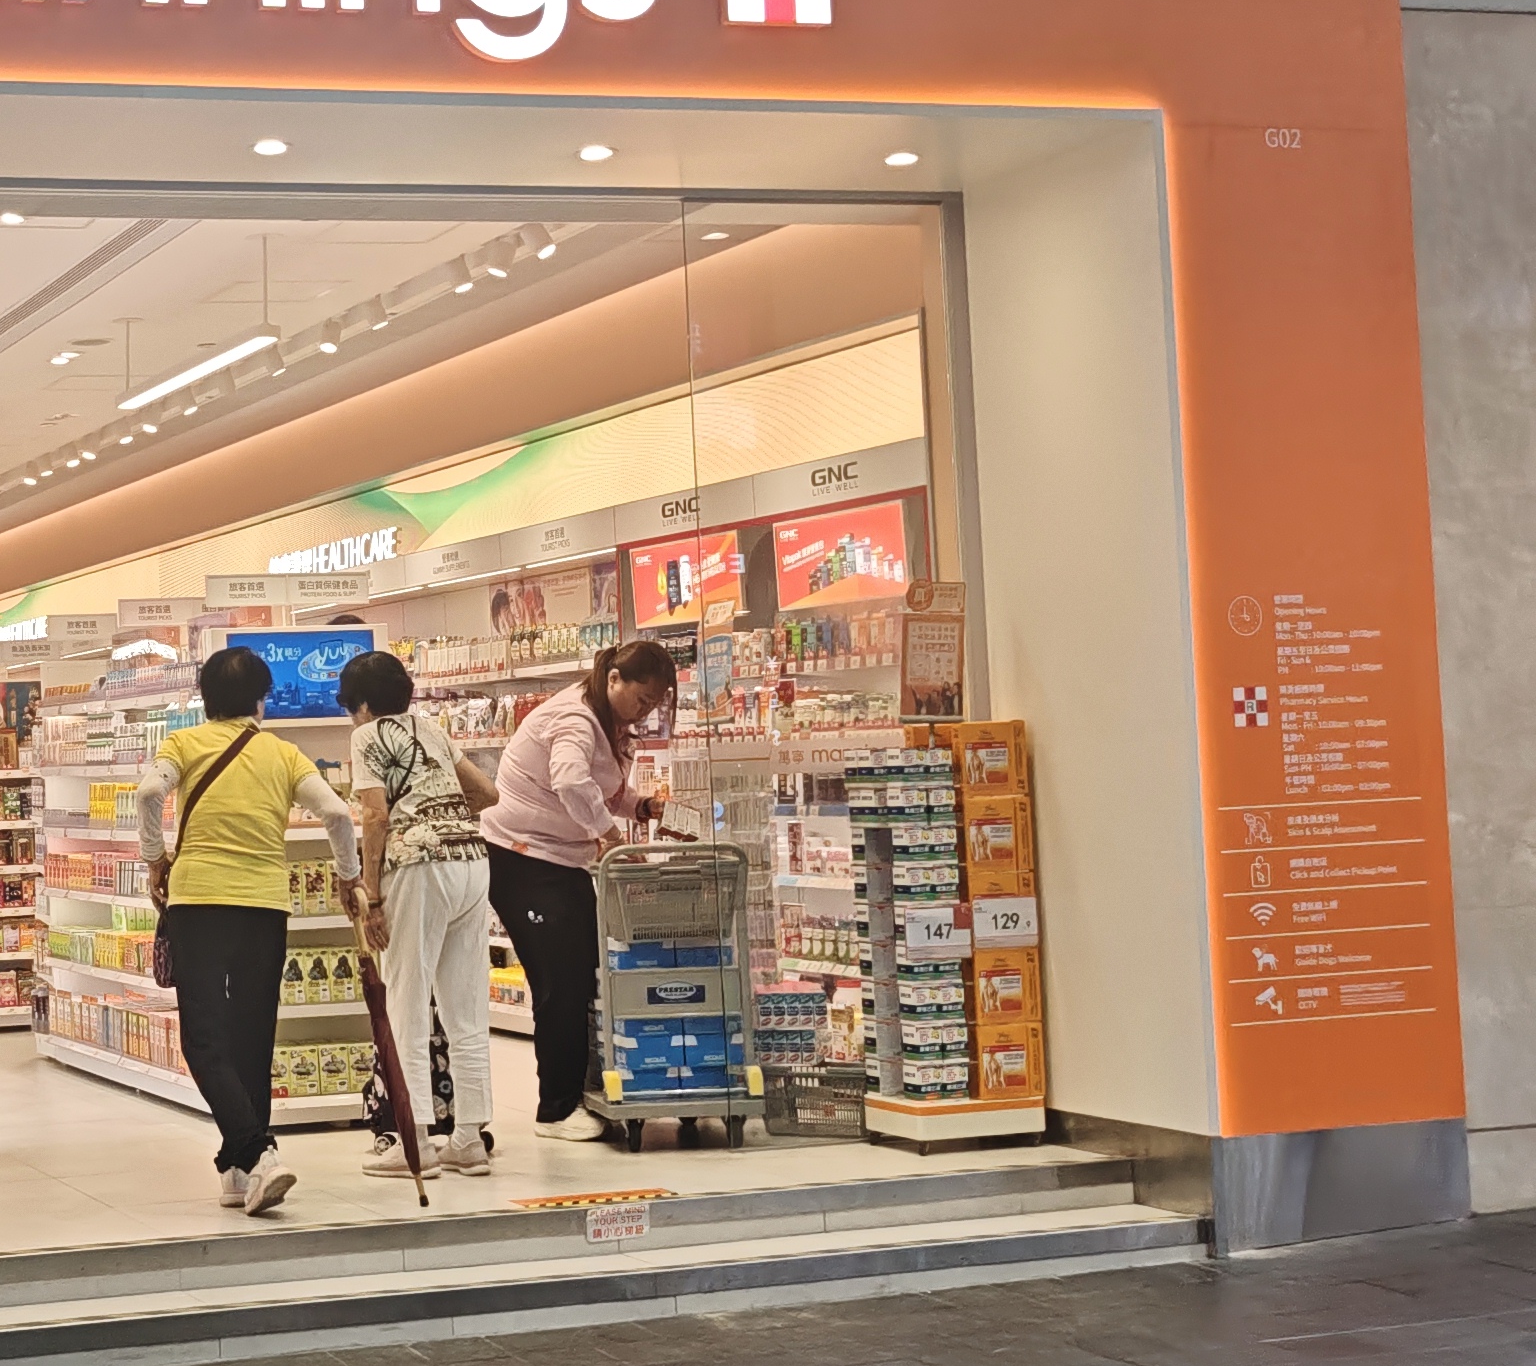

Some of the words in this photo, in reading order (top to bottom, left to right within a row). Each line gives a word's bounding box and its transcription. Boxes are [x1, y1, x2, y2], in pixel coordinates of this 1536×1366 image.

[1265, 128, 1301, 148] G02
[811, 461, 859, 487] GNC
[812, 485, 831, 497] LIVE
[835, 481, 859, 494] WELL
[661, 496, 700, 518] GNC
[662, 516, 679, 527] LIVE
[312, 526, 398, 573] HEALTHCARE
[228, 582, 265, 592] 旅客首選
[298, 580, 359, 591] 蛋白質保健食品
[138, 605, 171, 614] 旅客首選
[991, 912, 1020, 930] 129
[924, 922, 953, 941] 147
[658, 986, 694, 994] PRESTAR
[594, 1216, 618, 1225] YOUR
[620, 1214, 643, 1224] STEP
